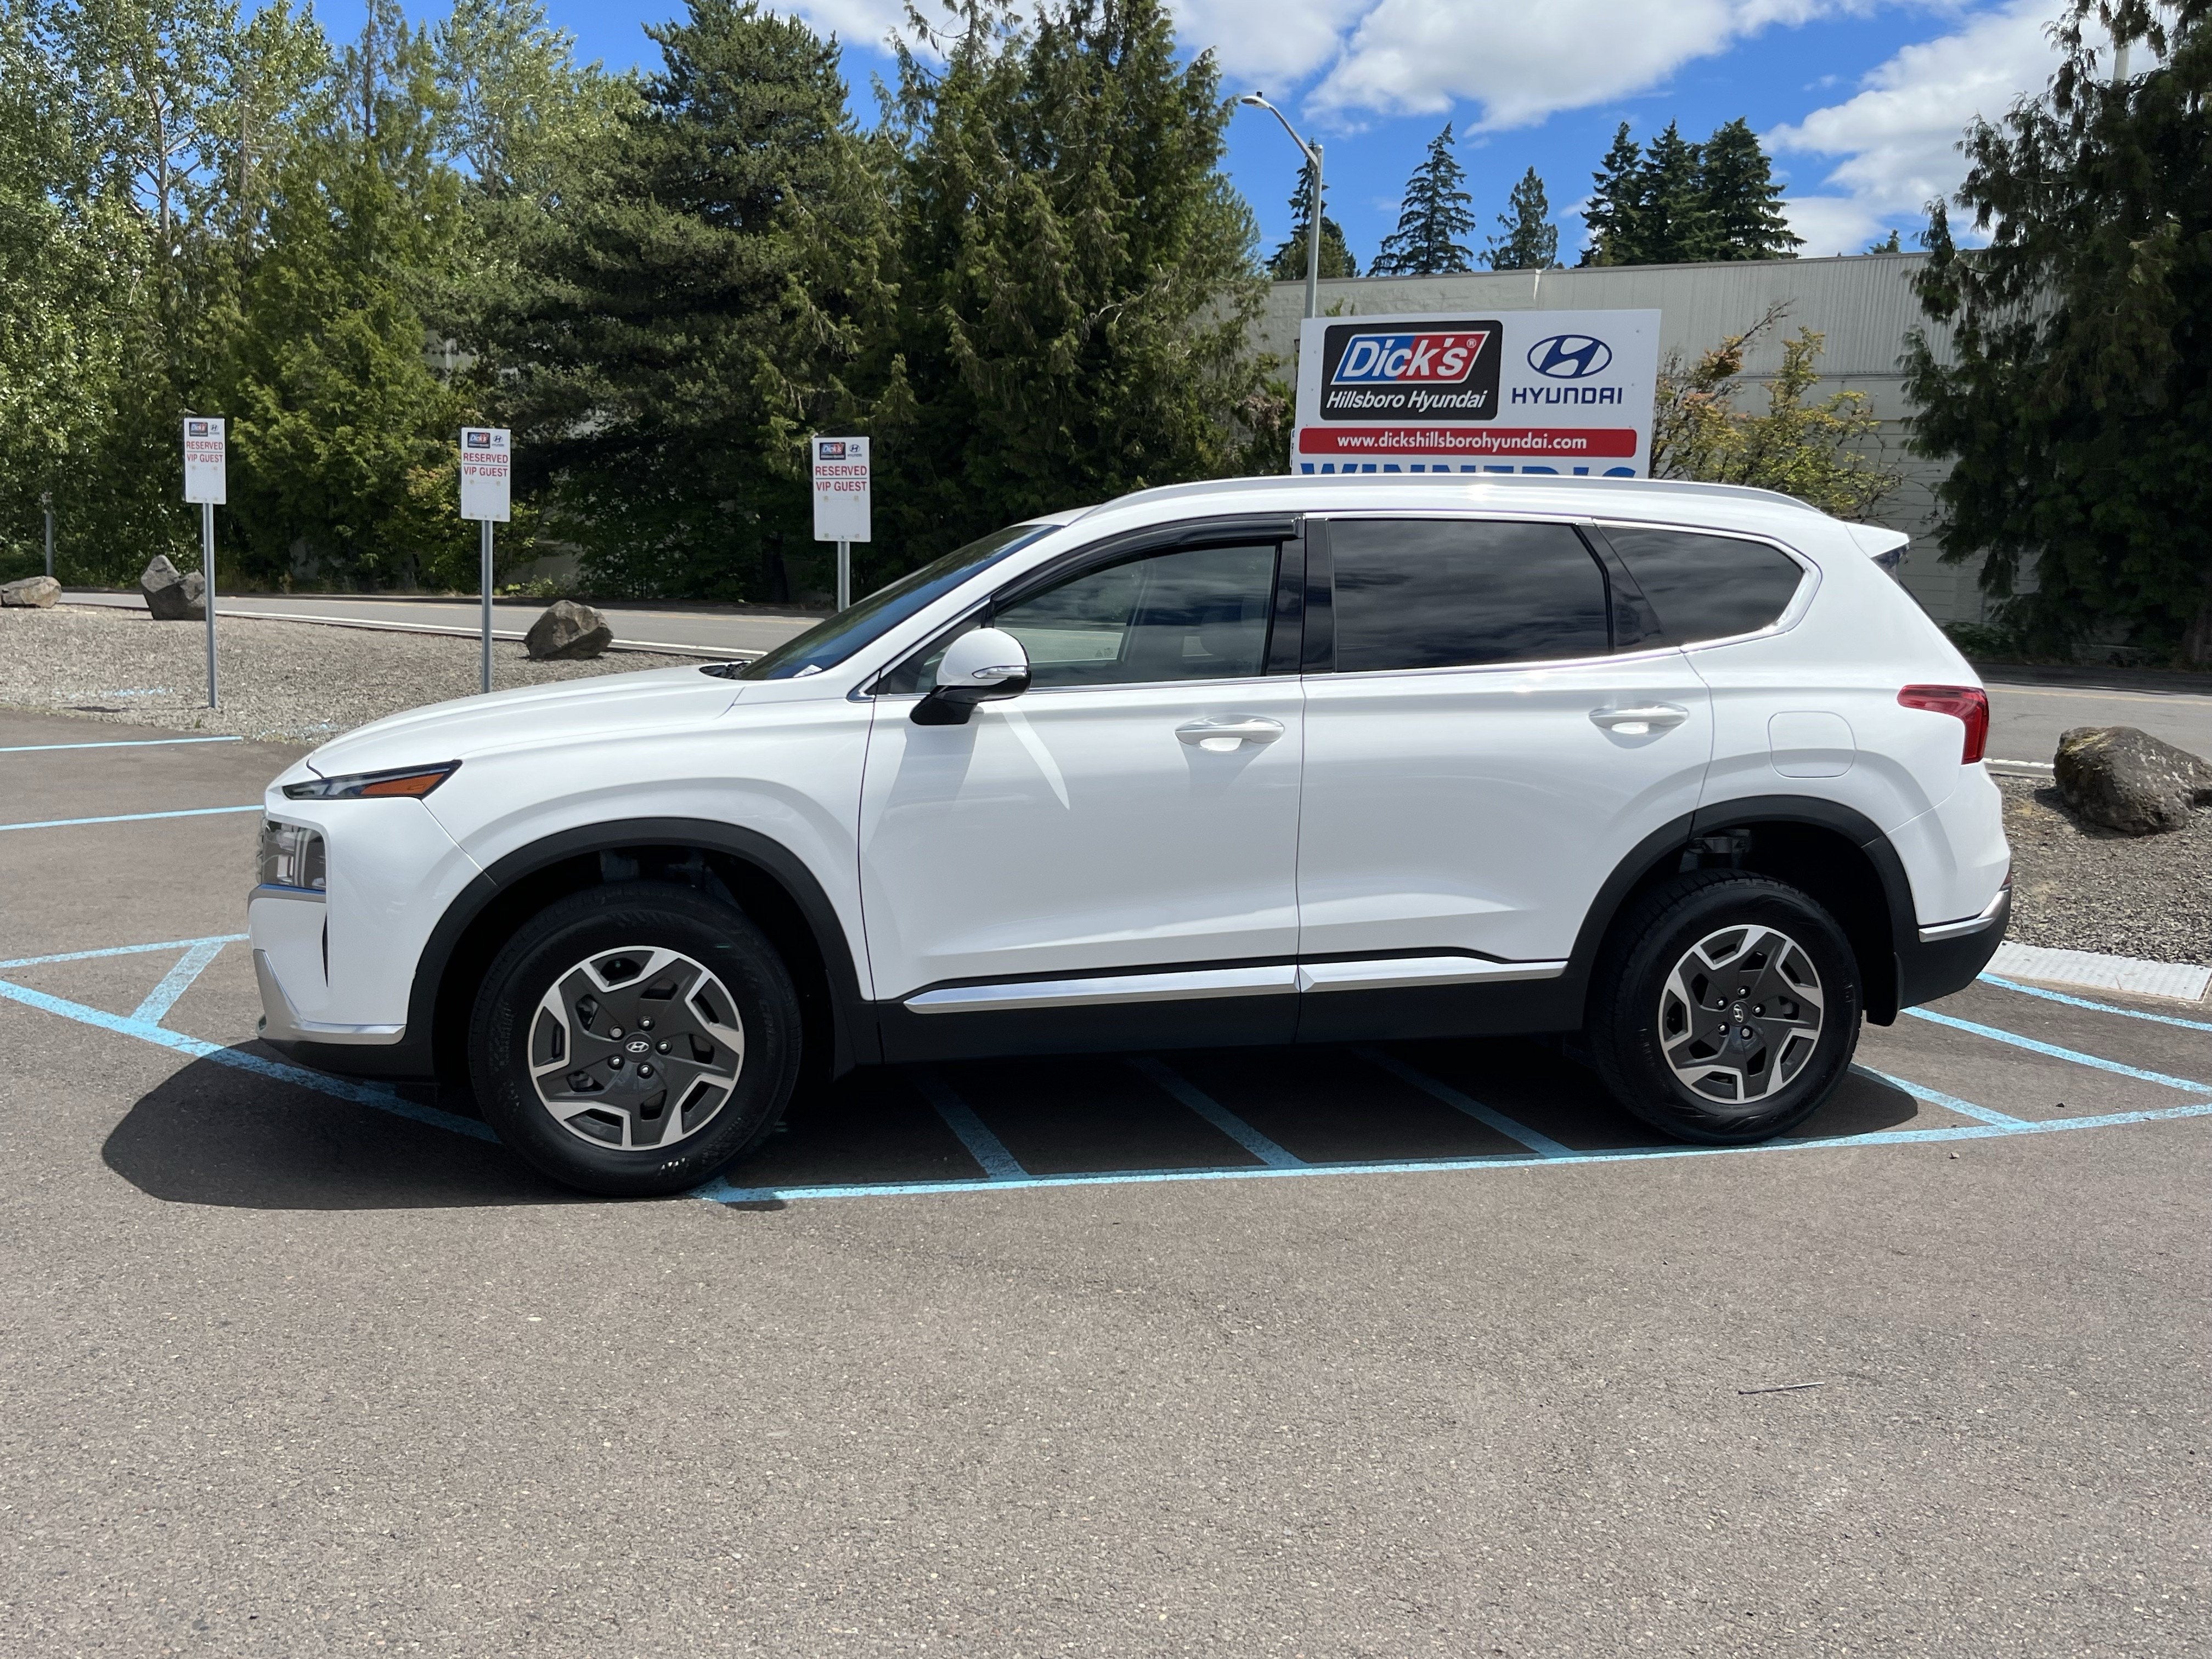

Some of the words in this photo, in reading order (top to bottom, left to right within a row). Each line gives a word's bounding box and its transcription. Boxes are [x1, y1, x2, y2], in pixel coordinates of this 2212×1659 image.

[1342, 338, 1468, 377] Dick's
[1512, 387, 1622, 404] HYUNDAI
[1326, 390, 1406, 409] Hillsboro
[1407, 390, 1488, 413] Hyundai
[186, 441, 223, 450] RESERVED
[1337, 431, 1587, 453] www.dickshillsborohyundai.com
[187, 454, 198, 462] VIP
[200, 454, 223, 462] GUEST
[463, 453, 508, 464] RESERVED
[464, 466, 477, 475] VIP
[479, 467, 507, 477] GUEST
[815, 466, 867, 476] RESERVED
[816, 481, 831, 491] VIP
[834, 481, 867, 491] GUEST
